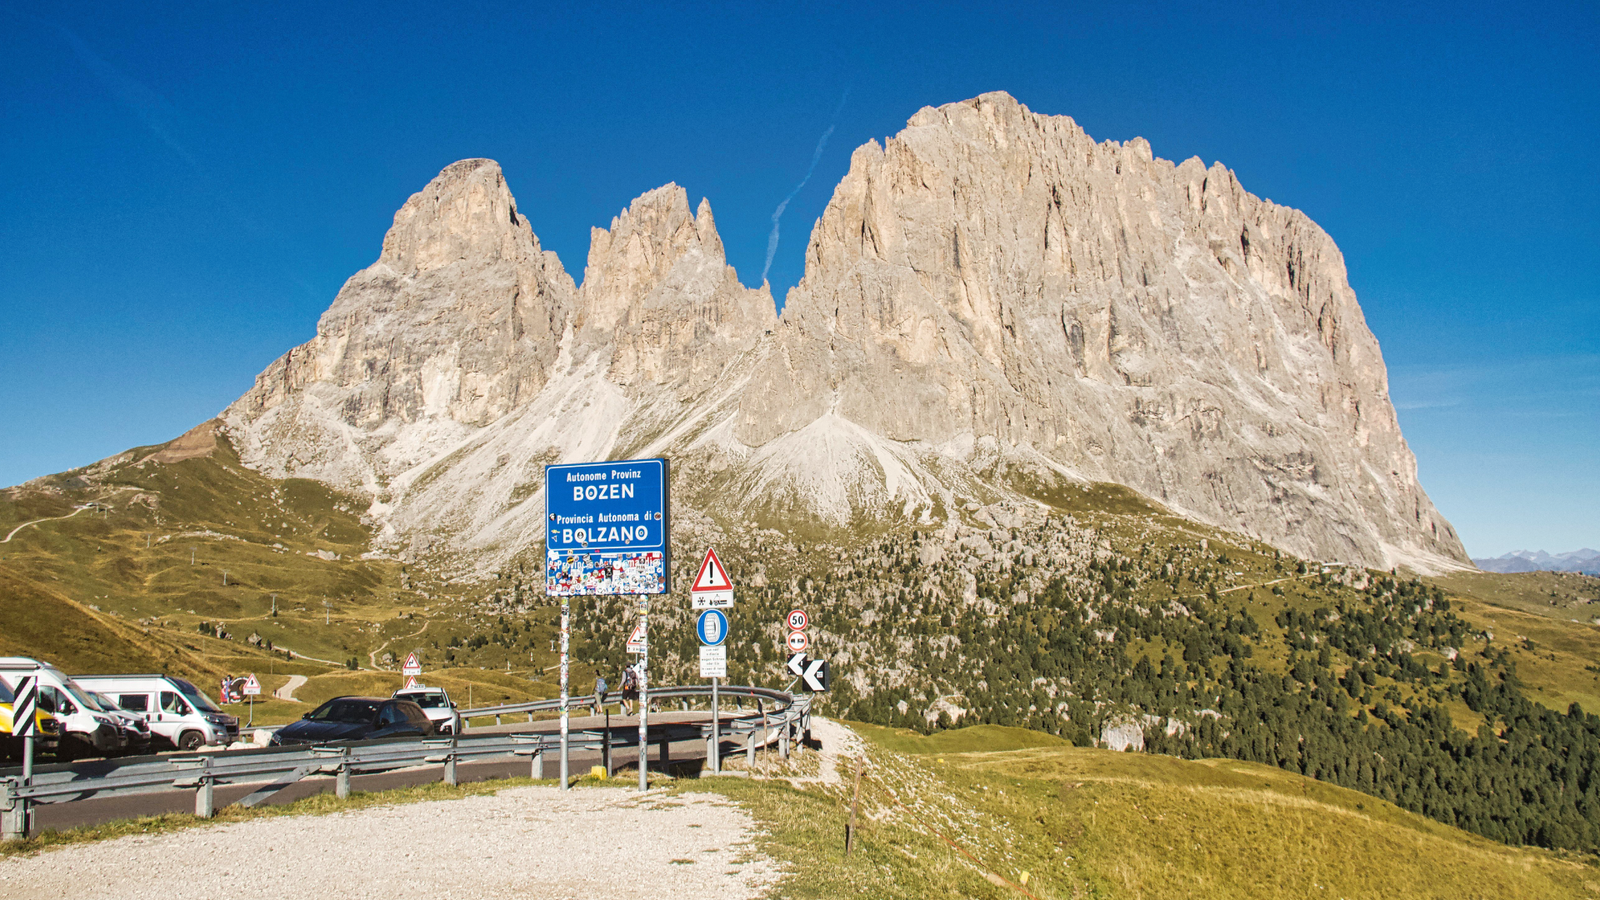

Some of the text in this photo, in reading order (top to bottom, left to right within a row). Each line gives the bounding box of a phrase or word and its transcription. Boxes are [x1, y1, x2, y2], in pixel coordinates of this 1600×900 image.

[567, 469, 641, 482] Autonome Provinz
[573, 483, 634, 501] BOZEN
[557, 511, 652, 524] Provincia Autonoma di
[562, 525, 648, 543] BOLZANO
[792, 616, 804, 625] 50
